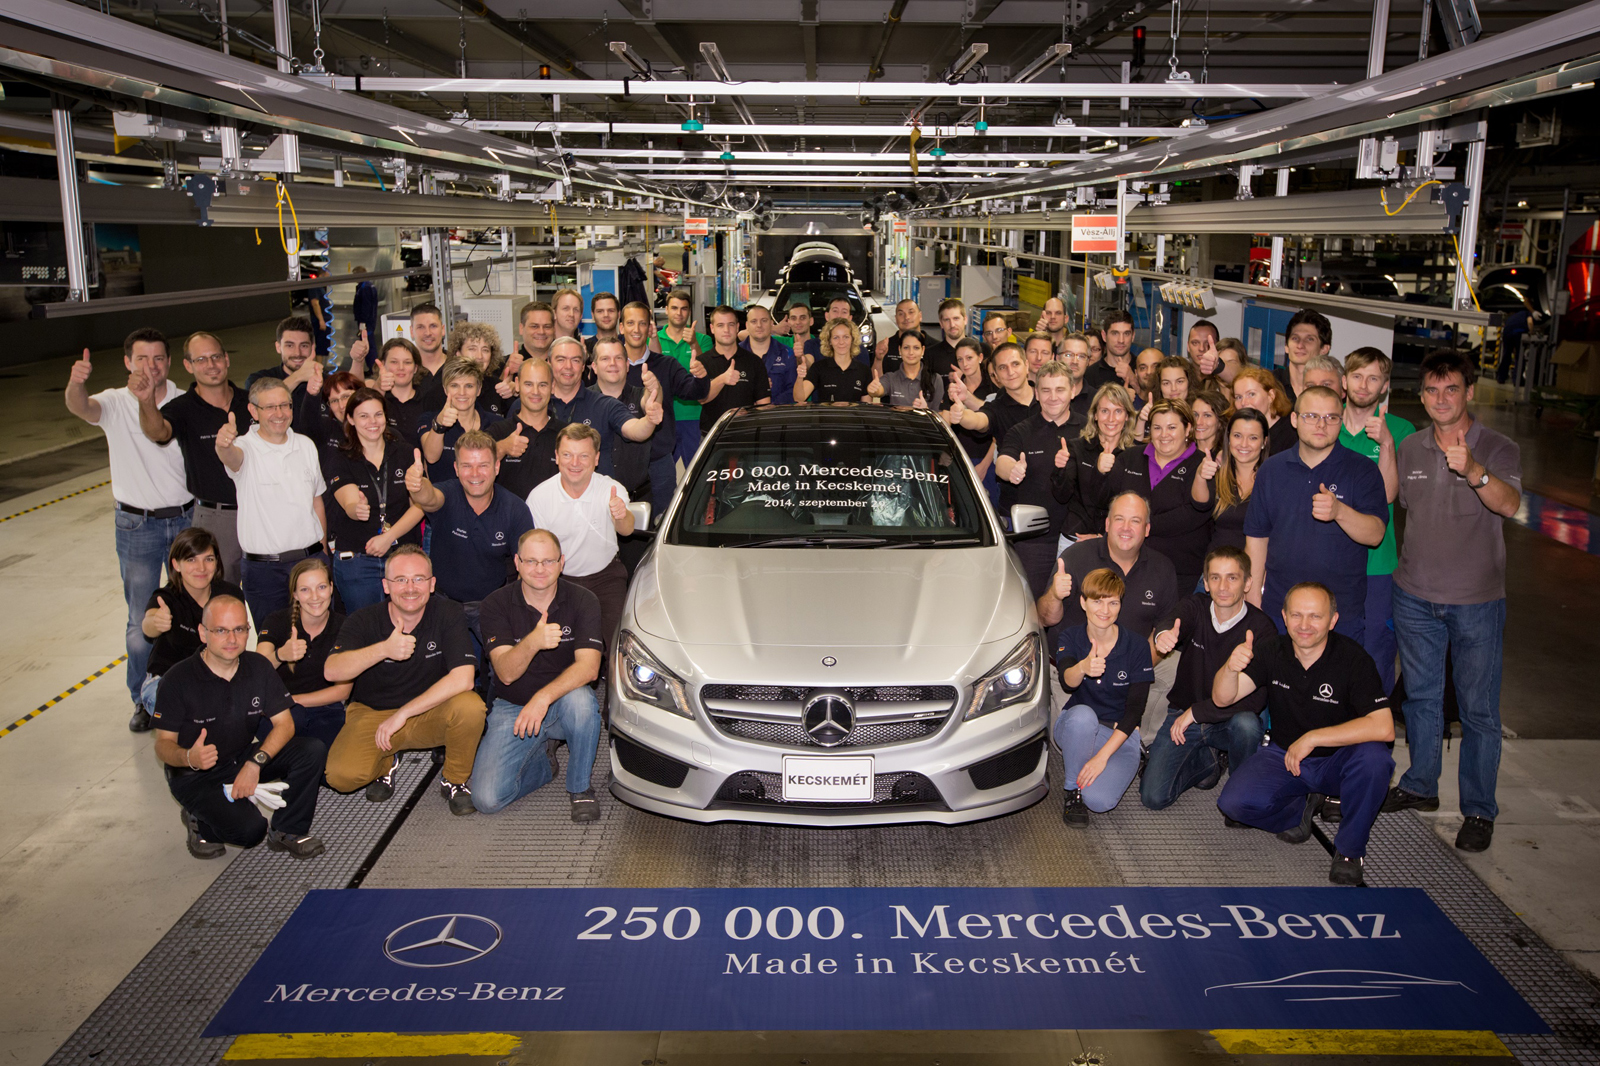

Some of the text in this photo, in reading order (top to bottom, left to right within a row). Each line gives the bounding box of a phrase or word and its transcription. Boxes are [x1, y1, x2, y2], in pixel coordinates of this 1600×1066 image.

[706, 464, 949, 484] 250 000. Mercedes-Benz
[747, 480, 902, 493] Made in Kecskemét
[764, 499, 795, 508] 2014.
[799, 499, 868, 508] szeptember
[788, 773, 868, 786] KECSKEMÉT
[576, 904, 1402, 941] 250 000. Mercedes-Benz
[722, 951, 1146, 975] Made in Kecskemét
[264, 982, 566, 1003] Mercedes-Benz
